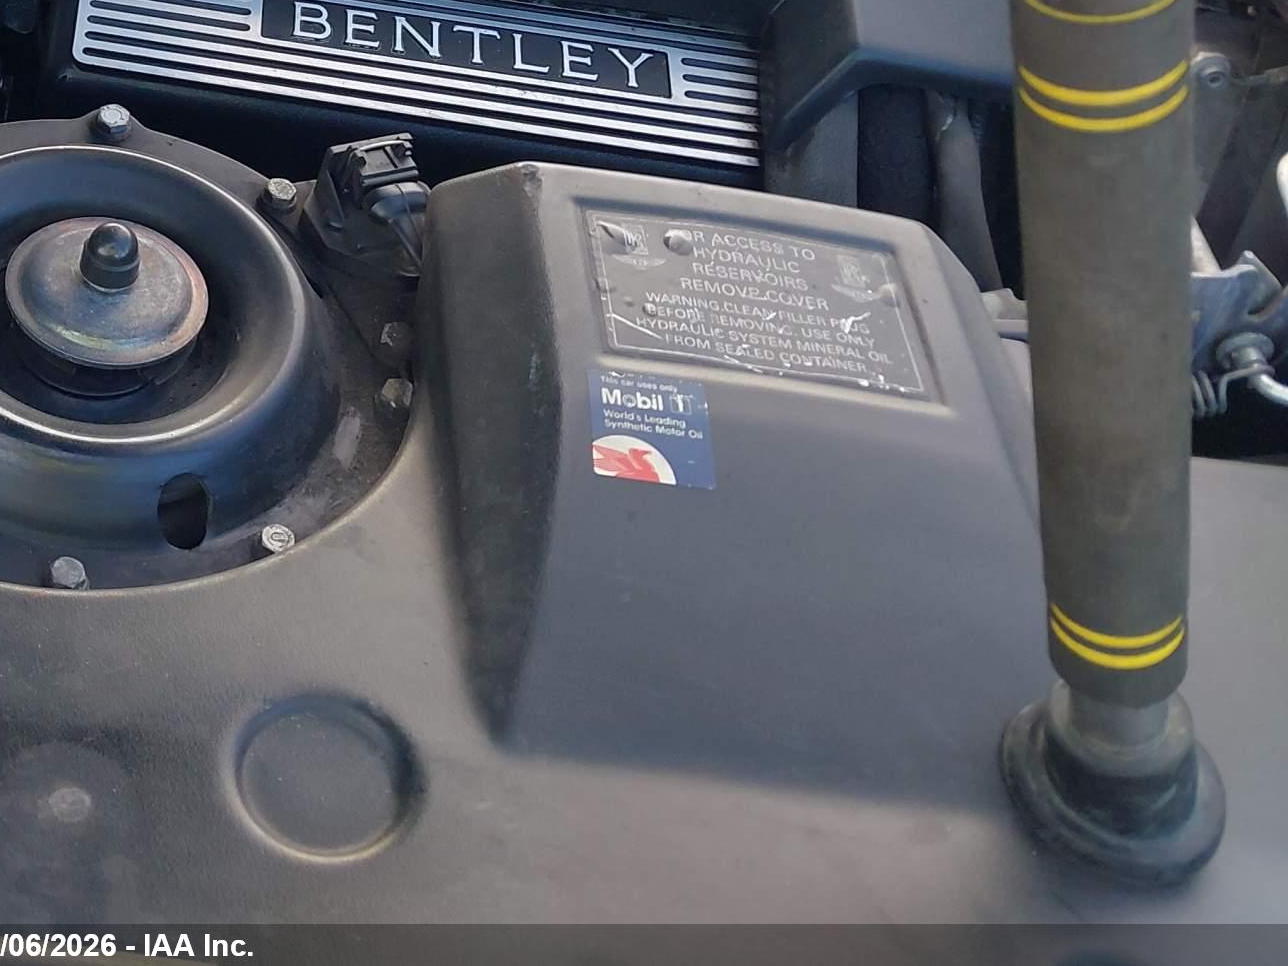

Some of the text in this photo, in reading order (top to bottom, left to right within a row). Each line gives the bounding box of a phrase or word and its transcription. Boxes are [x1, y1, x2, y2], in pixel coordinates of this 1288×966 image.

[290, 0, 655, 90] BENTLEY
[692, 247, 801, 274] HYDRAULIC
[711, 233, 785, 255] ACCESS
[789, 247, 816, 261] TO
[692, 262, 810, 292] RESERVOIRS
[679, 277, 830, 311] REMOVE COVER
[779, 311, 827, 328] FILLER
[636, 316, 894, 364] HYDRAULIC SYSTEM MINERAL OIL
[801, 326, 833, 341] USE
[836, 331, 876, 348] ONLY
[715, 341, 775, 362] SEALED
[779, 352, 868, 373] CONTAINER
[600, 375, 678, 394] This car uses only
[600, 387, 664, 411] Mobil
[603, 418, 704, 440] Synthetic Motor Oil
[644, 414, 687, 429] Leading
